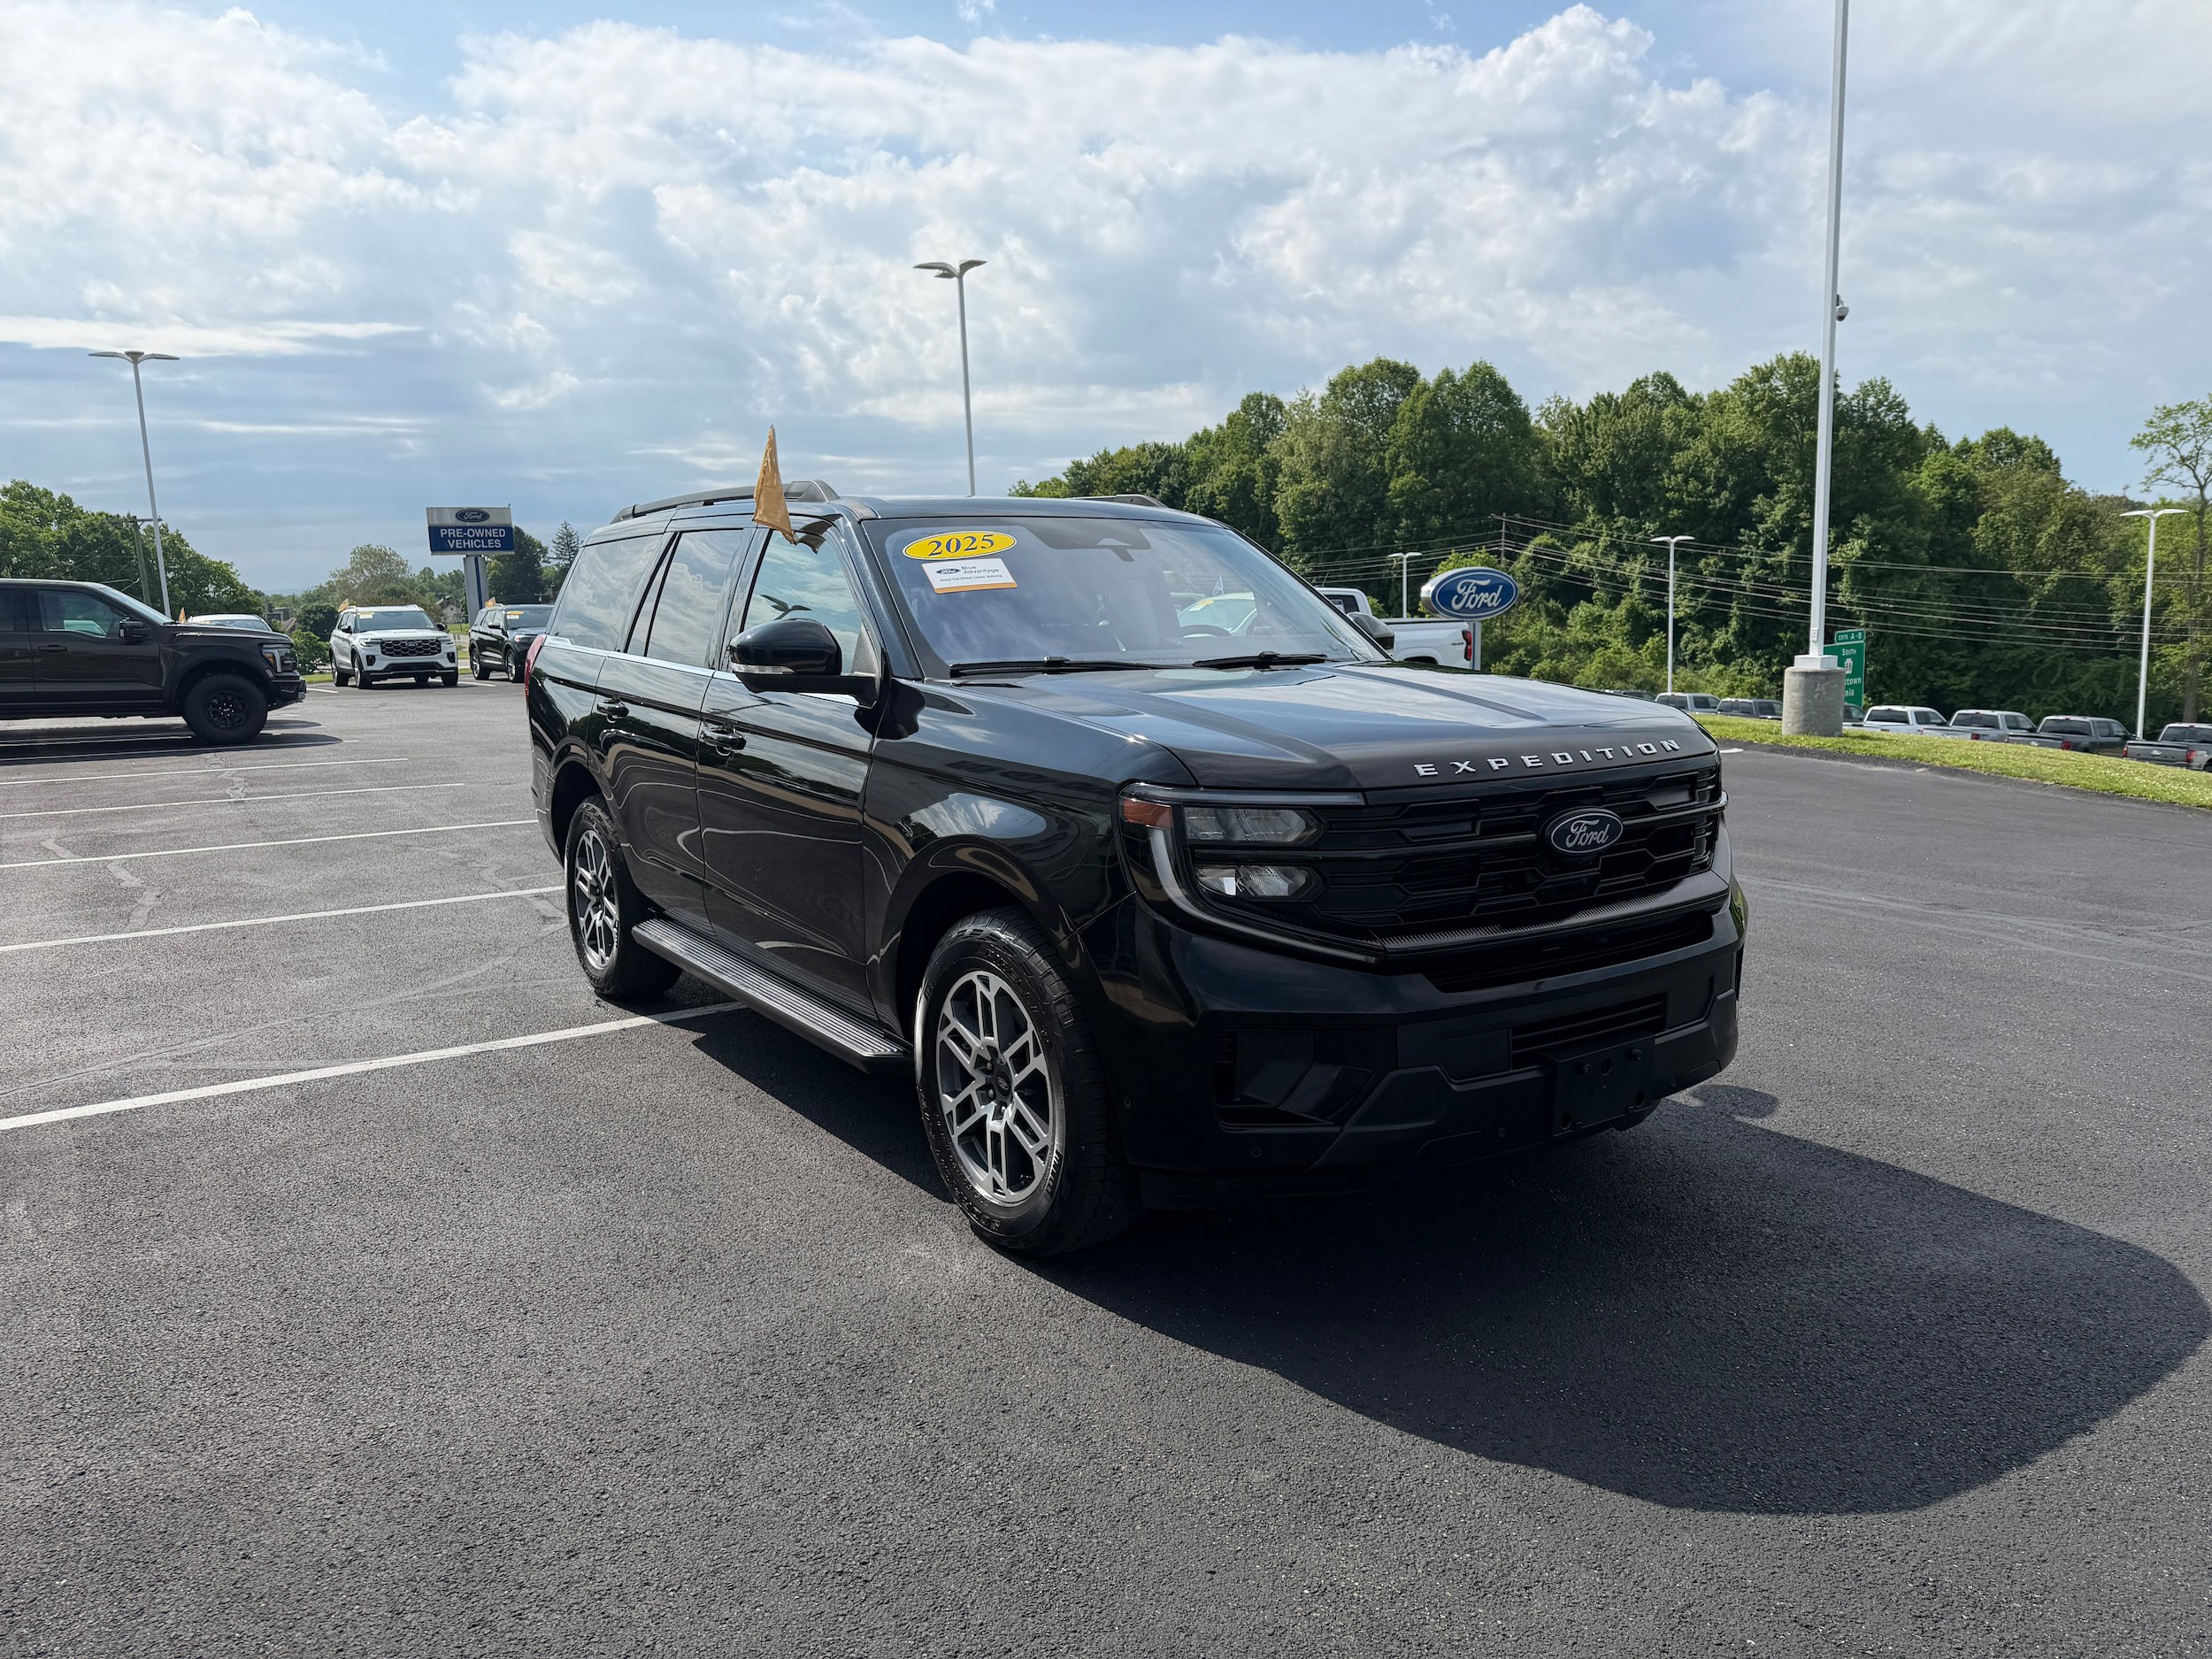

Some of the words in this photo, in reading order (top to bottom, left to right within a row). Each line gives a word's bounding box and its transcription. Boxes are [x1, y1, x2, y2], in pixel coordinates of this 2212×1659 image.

[440, 528, 506, 538] PRE-OWNED
[447, 539, 502, 549] VEHICLES
[927, 534, 995, 557] 2025
[1451, 579, 1504, 611] Ford
[1413, 739, 1681, 777] EXPEDITION
[1565, 818, 1610, 849] Ford
